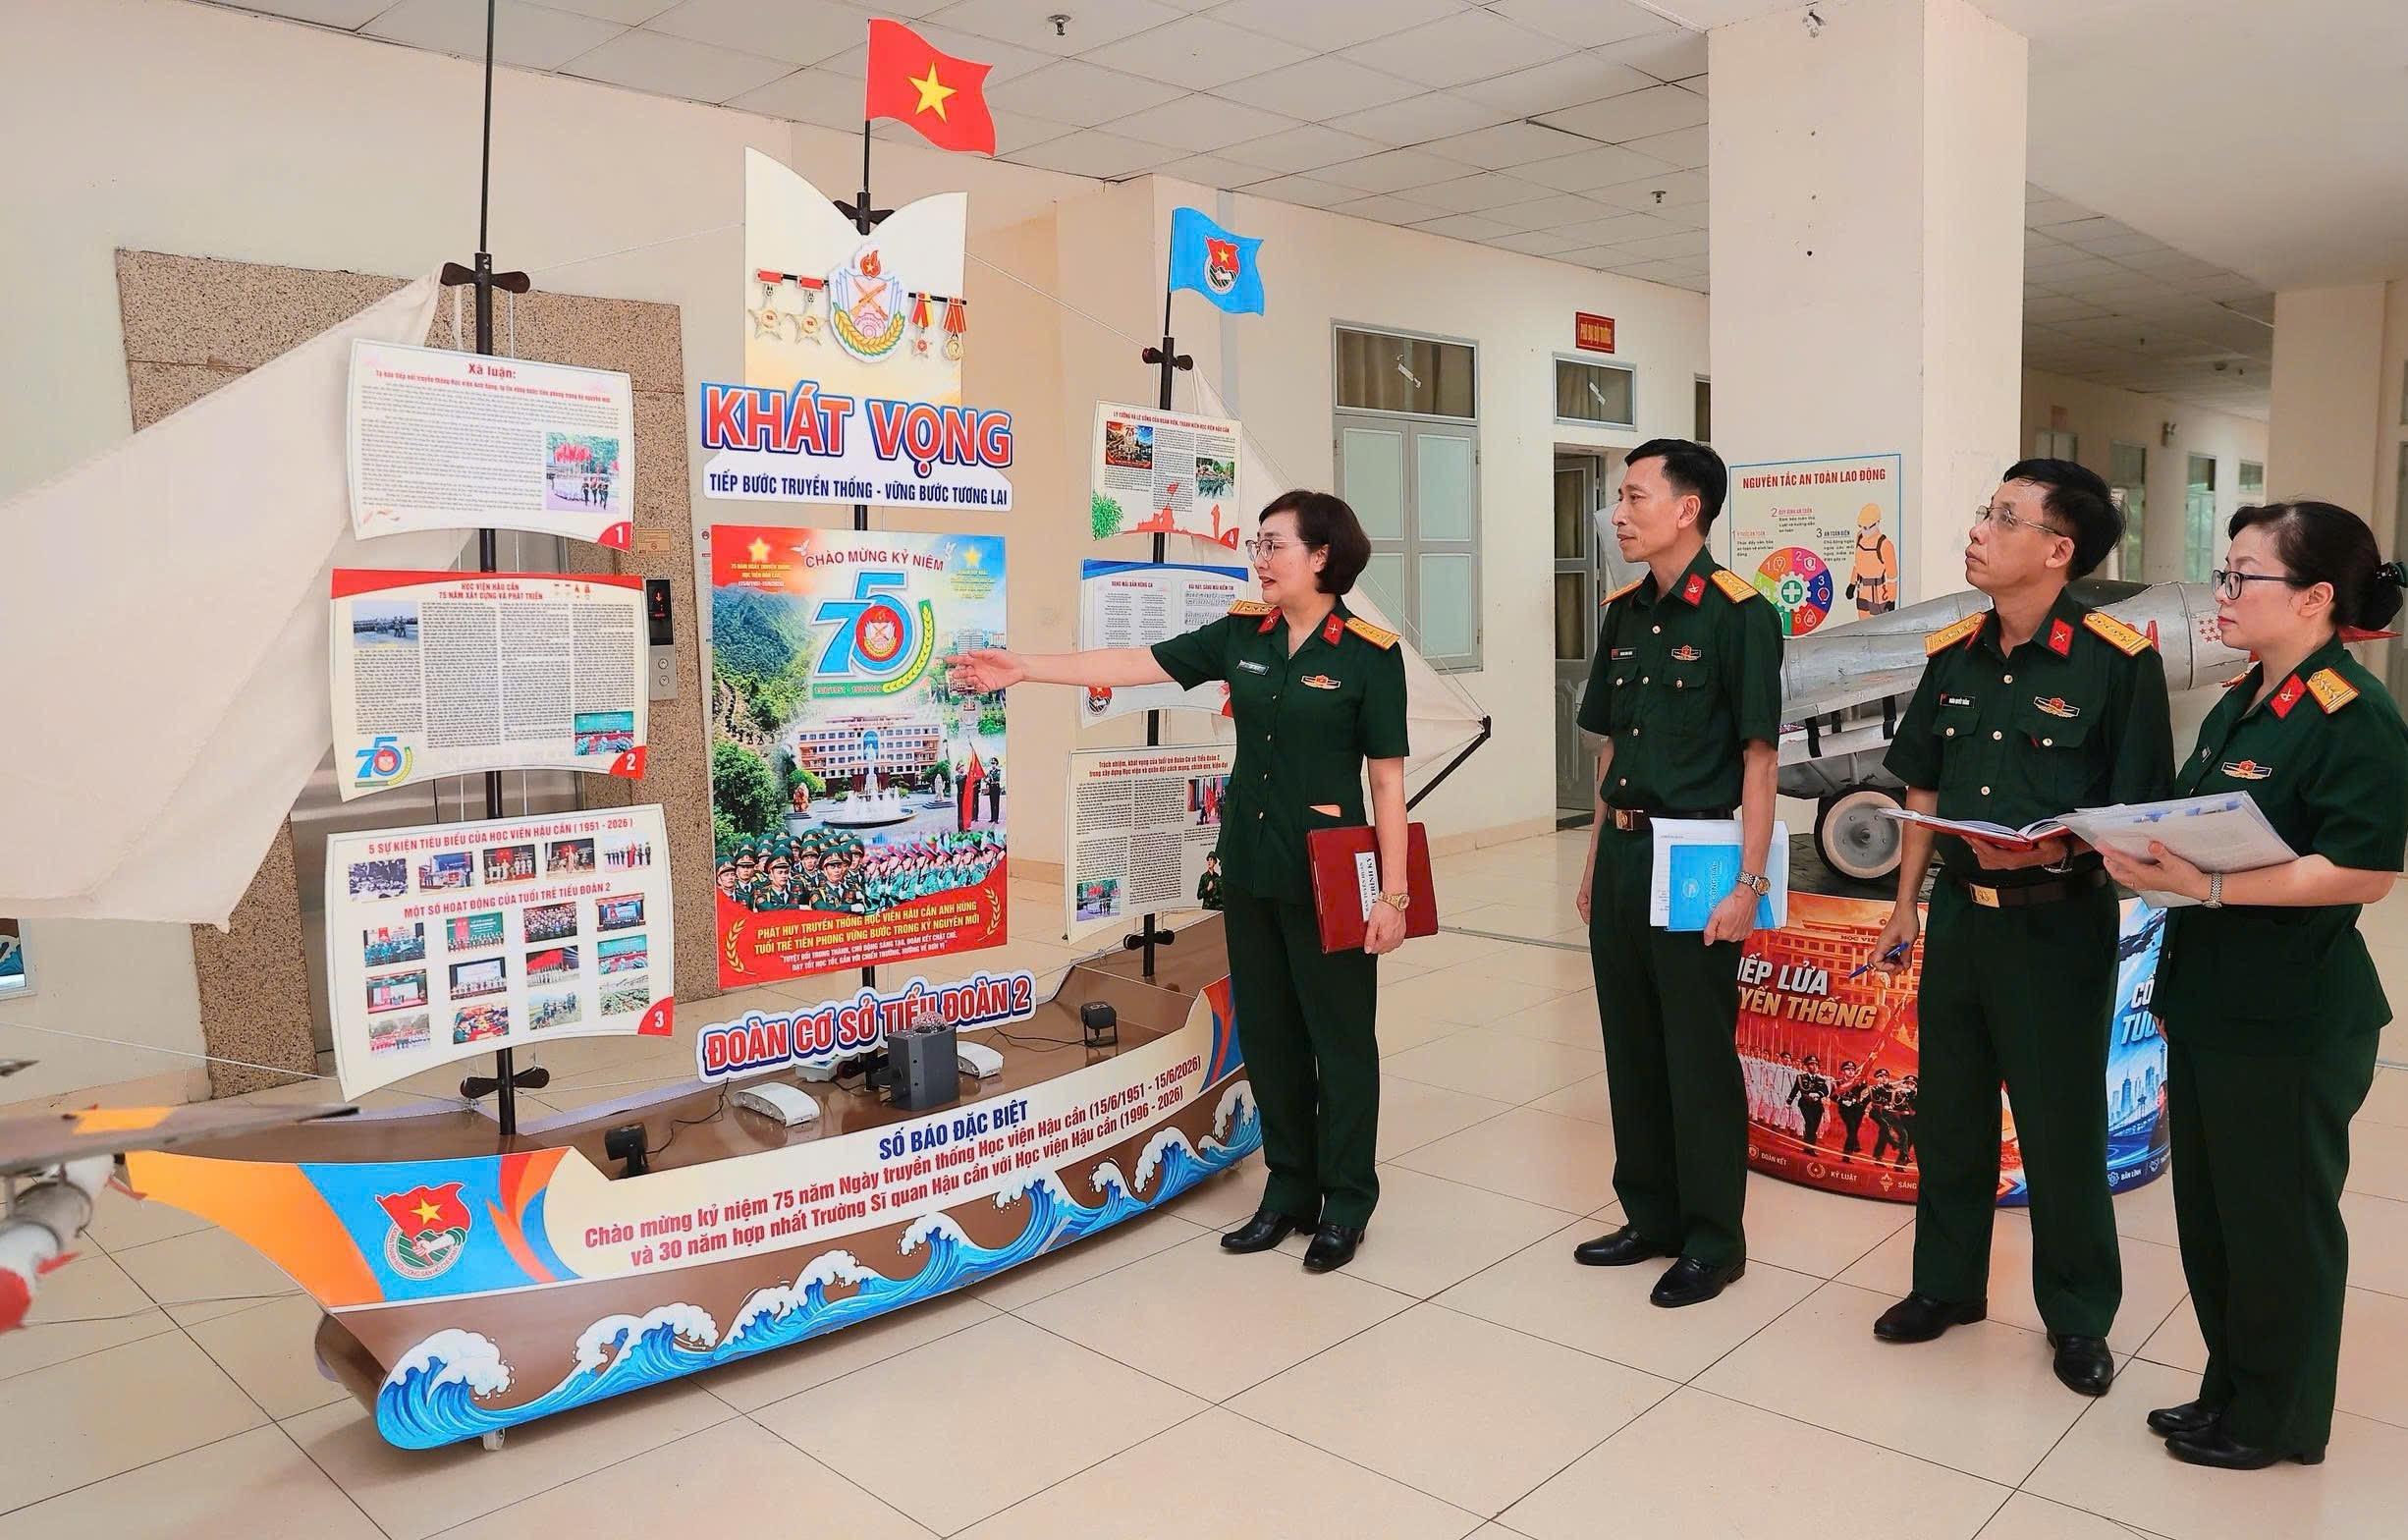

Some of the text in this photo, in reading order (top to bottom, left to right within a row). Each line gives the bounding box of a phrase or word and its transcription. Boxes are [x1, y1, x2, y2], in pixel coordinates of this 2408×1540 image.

[703, 380, 853, 457] KHÁT
[867, 400, 1012, 477] VỌNG
[710, 469, 1008, 505] TIẾP BƯỚC TRUYỀN THỐNG VỮNG BƯỚC TƯƠNG LAI
[1743, 467, 1886, 489] NGUYÊN TẮC AN TOÀN LAO ĐỘNG
[1771, 508, 1778, 518] 2
[616, 525, 624, 543] 1
[1229, 530, 1234, 545] 4
[1816, 527, 1823, 538] 3
[805, 550, 844, 568] CHÀO
[848, 547, 887, 563] MỪNG
[892, 549, 908, 565] KỶ
[912, 554, 944, 571] NIỆM
[1795, 551, 1802, 561] 2
[1818, 576, 1825, 585] 3
[812, 570, 915, 677] 75
[1794, 614, 1802, 624] 6
[356, 736, 402, 778] 75
[626, 752, 636, 771] 2
[368, 845, 375, 854] 5
[394, 838, 417, 852] KIỆN
[419, 836, 441, 849] TIÊU
[468, 830, 487, 844] CỦA
[490, 830, 508, 844] HỌC
[511, 827, 531, 840] VIỆN
[405, 908, 425, 918] MỘT
[443, 901, 467, 913] HOẠT
[469, 897, 496, 910] ĐỘNG
[498, 893, 517, 906] CỦA
[605, 882, 611, 892] 2
[757, 926, 781, 939] PHÁT
[782, 924, 799, 936] HUY
[835, 914, 862, 928] THỐNG
[864, 914, 880, 926] HỌC
[939, 905, 955, 915] ANH
[794, 935, 814, 949] TIÊN
[815, 933, 844, 946] PHONG
[870, 926, 892, 939] BƯỚC
[894, 923, 919, 935] TRONG
[933, 916, 963, 930] NGUYÊN
[965, 913, 980, 925] MỚI
[1736, 952, 1829, 996] IẾP LỬA
[654, 1010, 665, 1028] 3
[705, 1019, 789, 1071] ĐOÀN
[794, 1010, 835, 1054] CƠ
[839, 996, 877, 1047] SỞ
[942, 979, 1010, 1024] ĐOÀN
[1012, 977, 1031, 1011] 2
[1737, 985, 1878, 1030] YẾN THỐNG
[879, 1099, 1027, 1160] SỐ BÁO ĐẶC BIỆT
[584, 1055, 1201, 1248] Chào mừng kỷ niệm 75 năm Ngày truyền thống Học viện Hậu cần (15/6/1951 15/6/2026)
[630, 1085, 1184, 1267] và 30 năm hợp nhất Trường Sĩ quan Hậu cần với Học viện Hậu cần (1996 2026)
